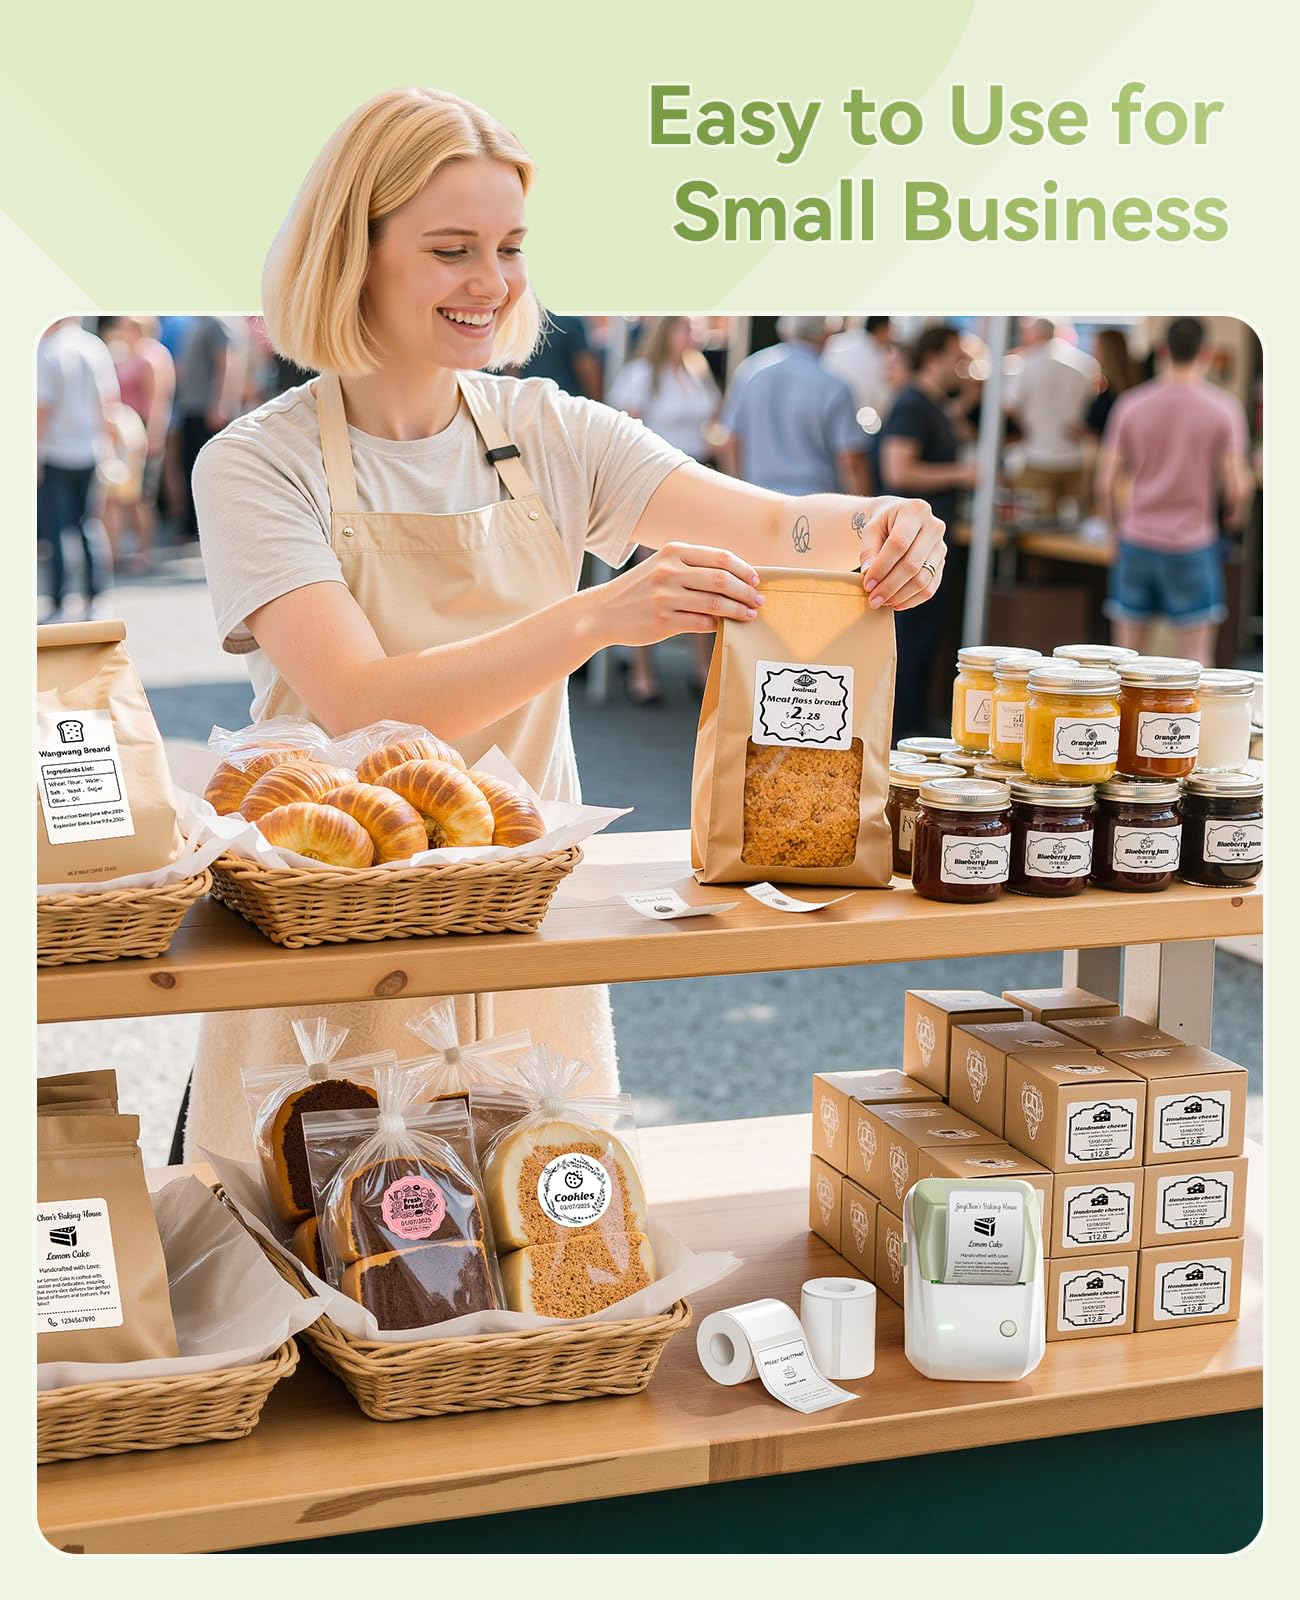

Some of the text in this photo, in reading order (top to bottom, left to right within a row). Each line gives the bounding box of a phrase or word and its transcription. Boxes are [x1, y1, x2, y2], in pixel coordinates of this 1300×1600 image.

[791, 697, 812, 705] floss
[814, 698, 842, 706] bread
[38, 745, 110, 758] Wangwang Breand
[46, 768, 80, 776] Ingredients
[554, 1192, 595, 1202] Cookies
[404, 1202, 423, 1210] Bread
[58, 1211, 81, 1221] Baking
[82, 1209, 101, 1218] House
[989, 1240, 1003, 1248] Cake
[46, 1250, 90, 1260] Lemon Cake
[39, 1265, 72, 1273] Handcrafted
[60, 1316, 96, 1324] 1234567890
